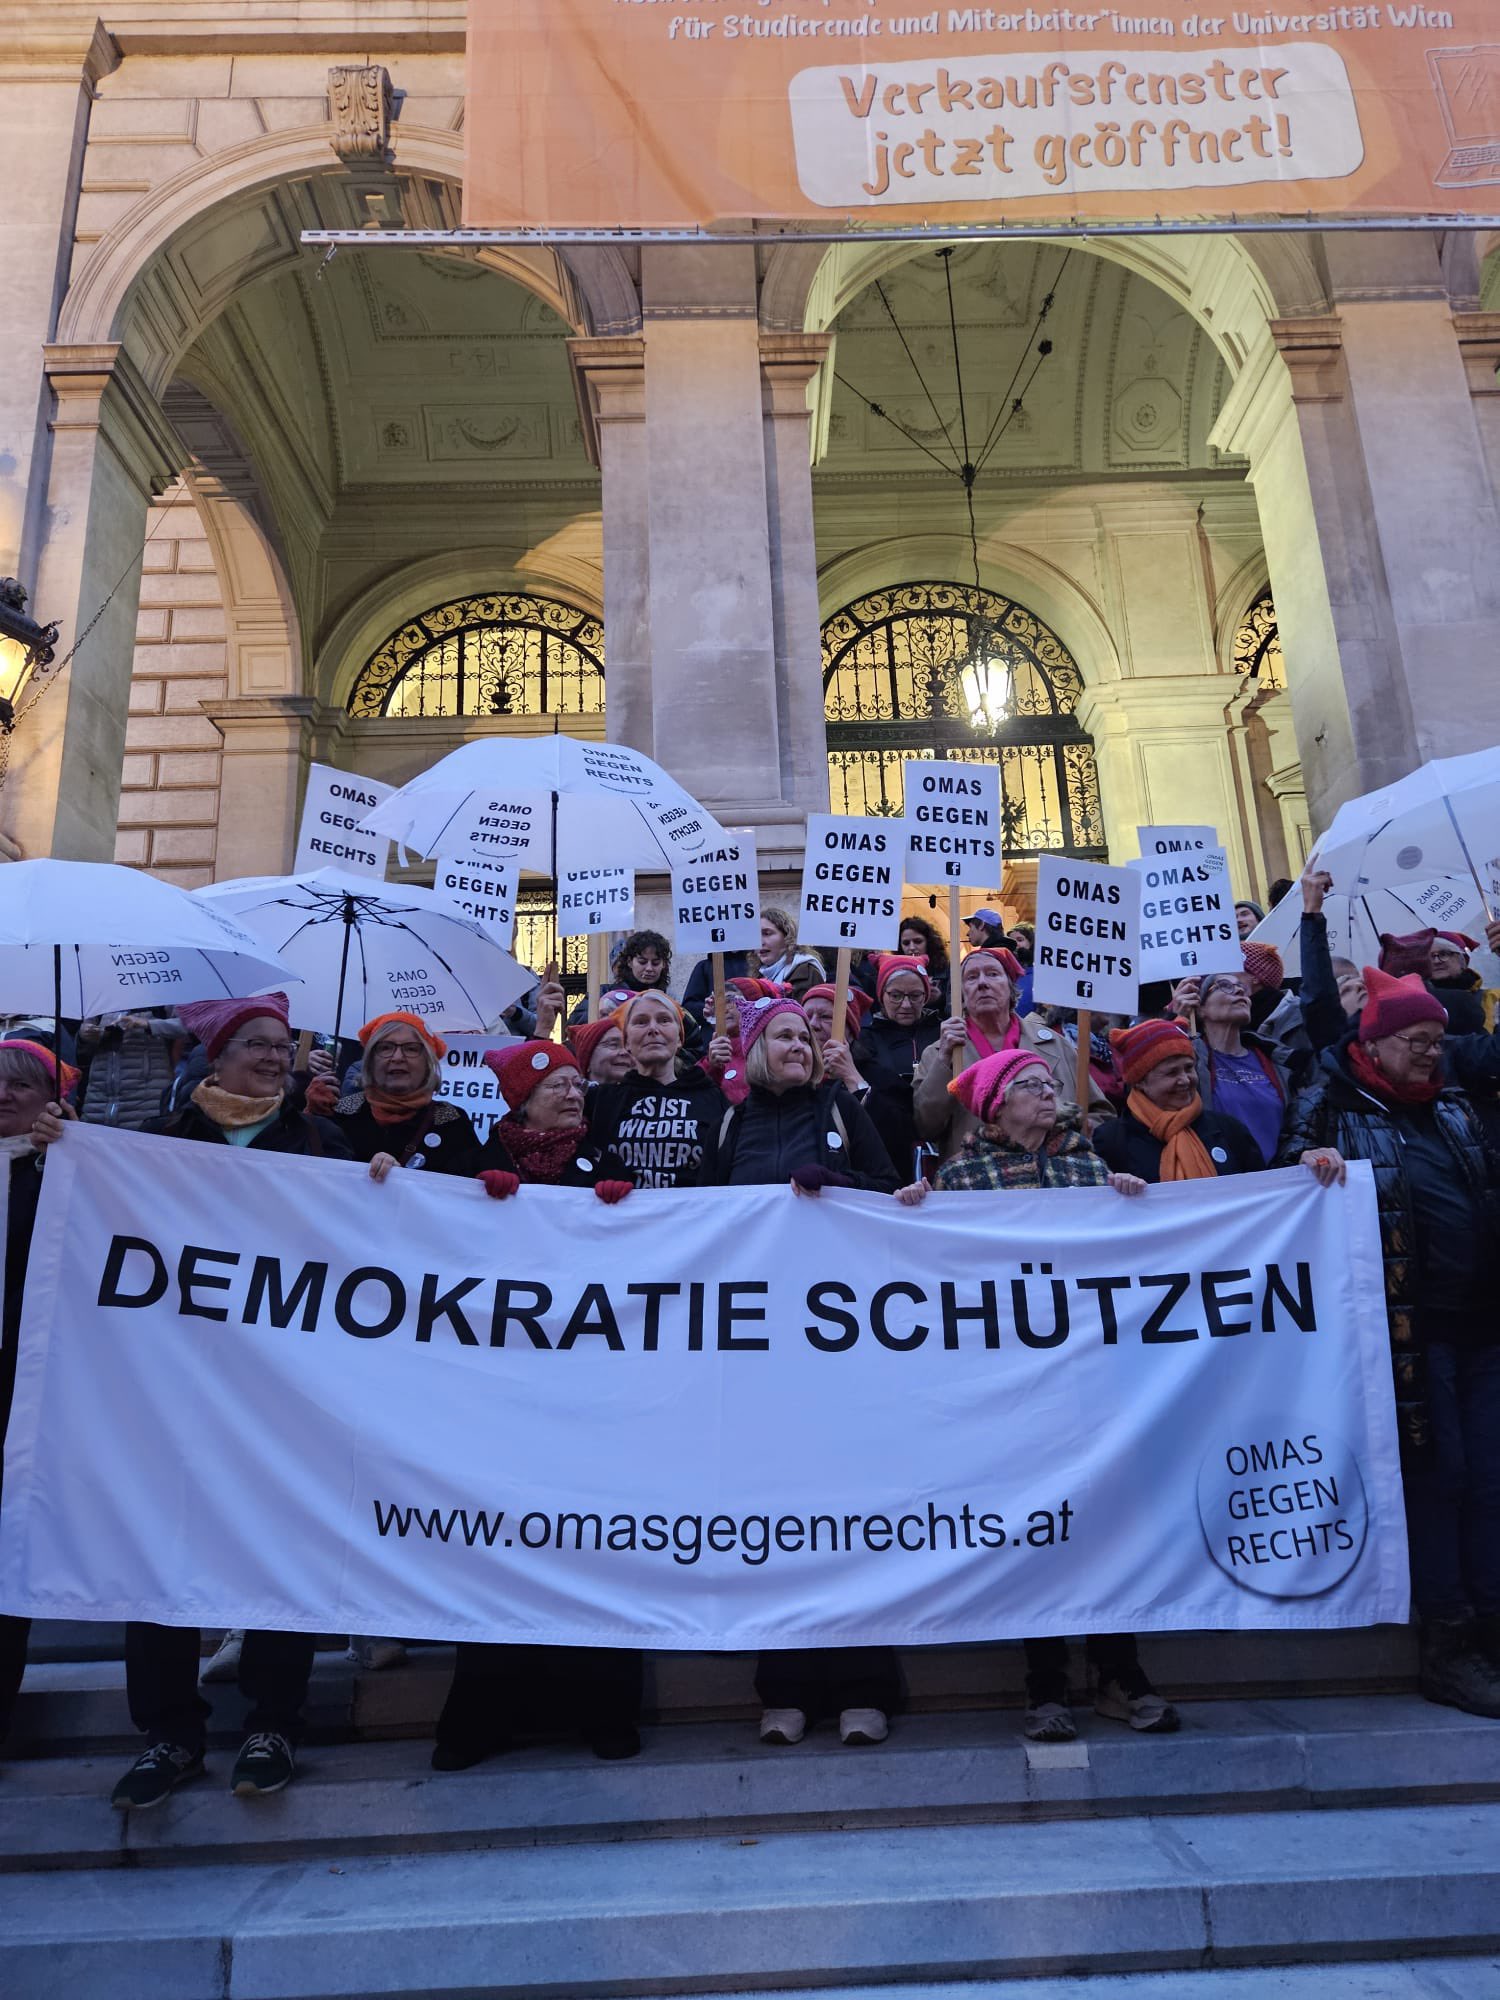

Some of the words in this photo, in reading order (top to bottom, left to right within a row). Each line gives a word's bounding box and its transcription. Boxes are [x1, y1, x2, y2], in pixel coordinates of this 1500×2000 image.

[668, 16, 717, 40] für
[723, 14, 881, 38] Studierende
[888, 11, 939, 35] und
[1182, 13, 1225, 37] der
[1232, 5, 1381, 35] Universität
[1387, 4, 1454, 28] Wien
[838, 59, 1290, 118] Verkaufsfenster
[862, 124, 1014, 196] jetzt
[1034, 113, 1294, 185] geöffnet!
[582, 748, 631, 761] OMAS
[583, 757, 642, 773] GEGEN
[585, 768, 654, 787] RECHTS
[922, 776, 982, 796] OMAS
[329, 784, 378, 807] OMAS
[916, 805, 988, 826] GEGEN
[310, 838, 377, 866] RECHTS
[825, 831, 887, 852] OMAS
[910, 835, 995, 857] RECHTS
[682, 873, 747, 893] GEGEN
[815, 862, 890, 884] GEGEN
[1146, 865, 1210, 888] OMAS
[445, 874, 507, 898] GEGEN
[1056, 877, 1121, 905] OMAS
[562, 887, 630, 909] RECHTS
[806, 894, 894, 916] RECHTS
[1143, 893, 1221, 919] GEGEN
[678, 902, 755, 924] RECHTS
[1048, 912, 1126, 941] GEGEN
[1140, 923, 1232, 950] RECHTS
[1040, 946, 1133, 977] RECHTS
[447, 1050, 489, 1068] OM
[439, 1080, 500, 1100] GEGE
[631, 1096, 657, 1117] ES
[659, 1097, 692, 1118] IST
[618, 1118, 698, 1140] WIEDER
[98, 1234, 769, 1352] DEMOKRATIE
[804, 1261, 1318, 1352] SCHÜTZEN
[1226, 1435, 1323, 1477] OMAS
[1227, 1476, 1339, 1522] GEGEN
[373, 1499, 1074, 1565] www.omasgegenrechts.at
[1228, 1519, 1353, 1567] RECHTS
